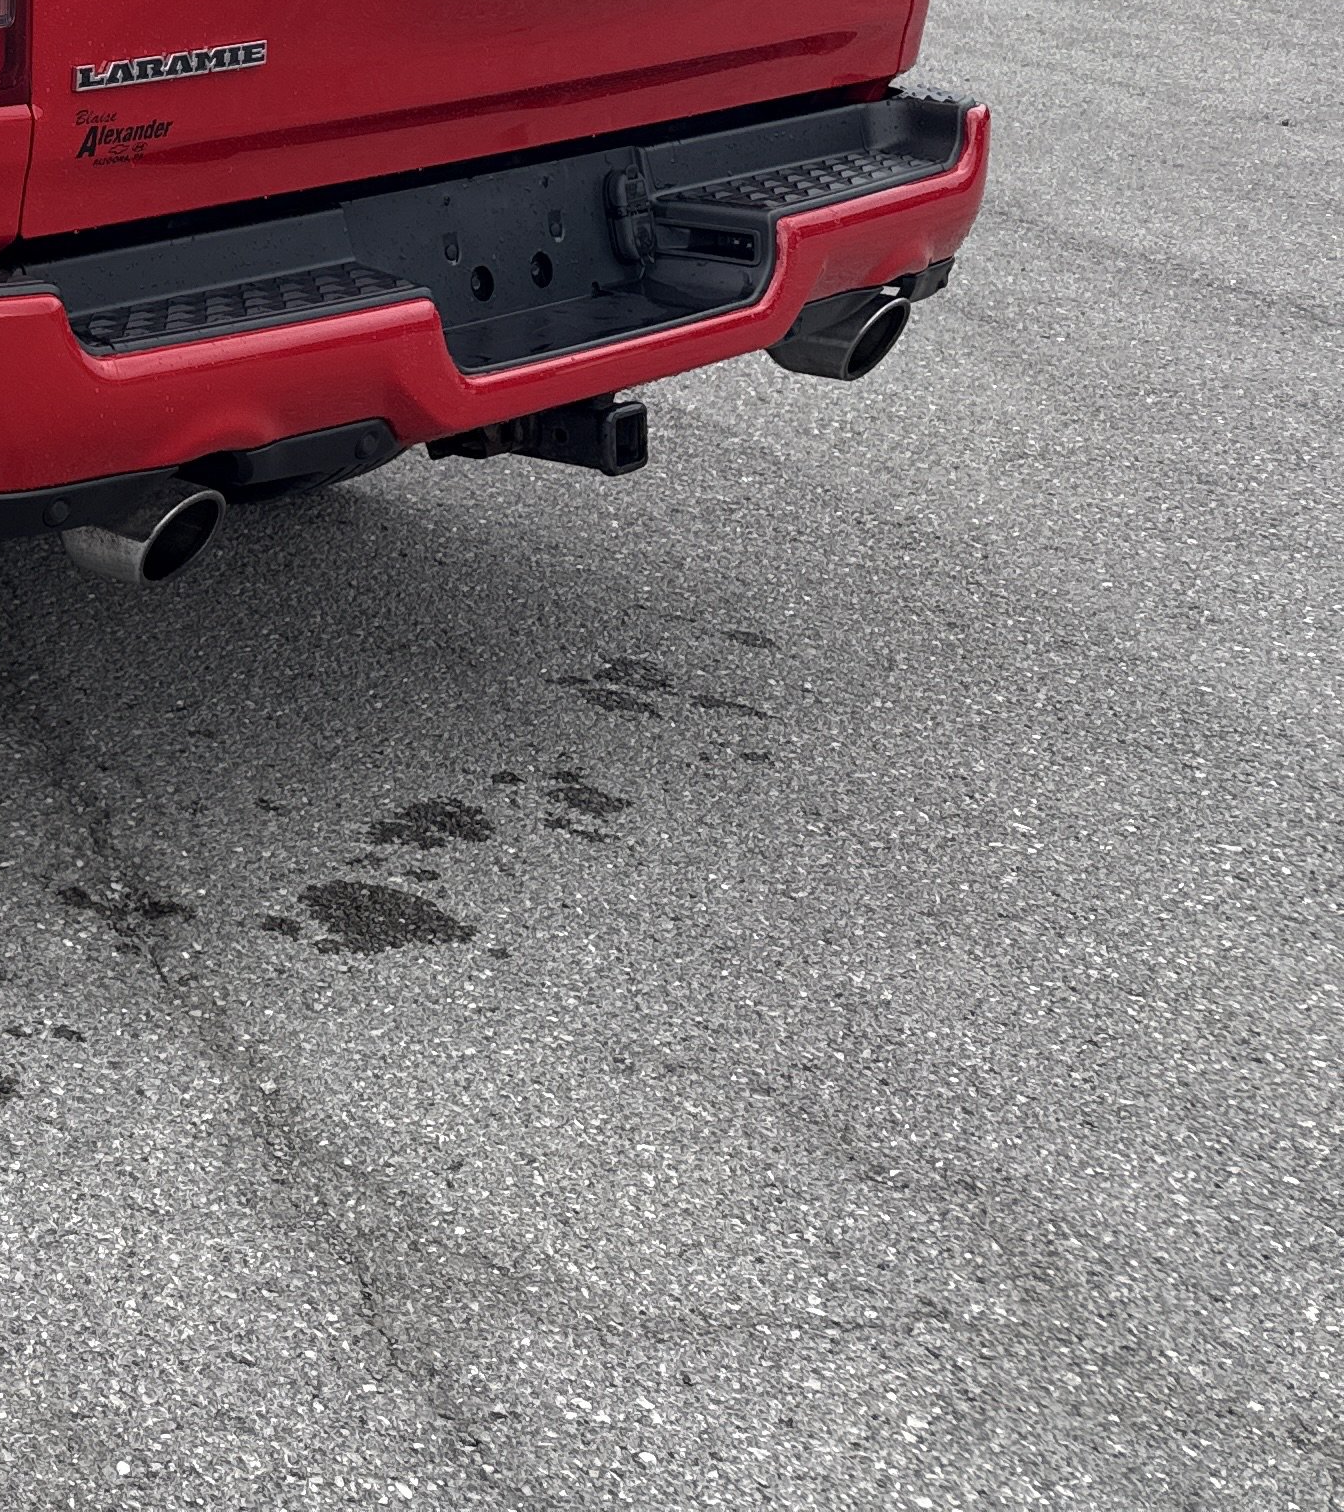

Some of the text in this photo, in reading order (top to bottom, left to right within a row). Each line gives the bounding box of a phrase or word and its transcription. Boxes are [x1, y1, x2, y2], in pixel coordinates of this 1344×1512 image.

[75, 39, 268, 91] LARAMIE
[75, 109, 118, 126] Blaise
[76, 118, 174, 159] Alexander
